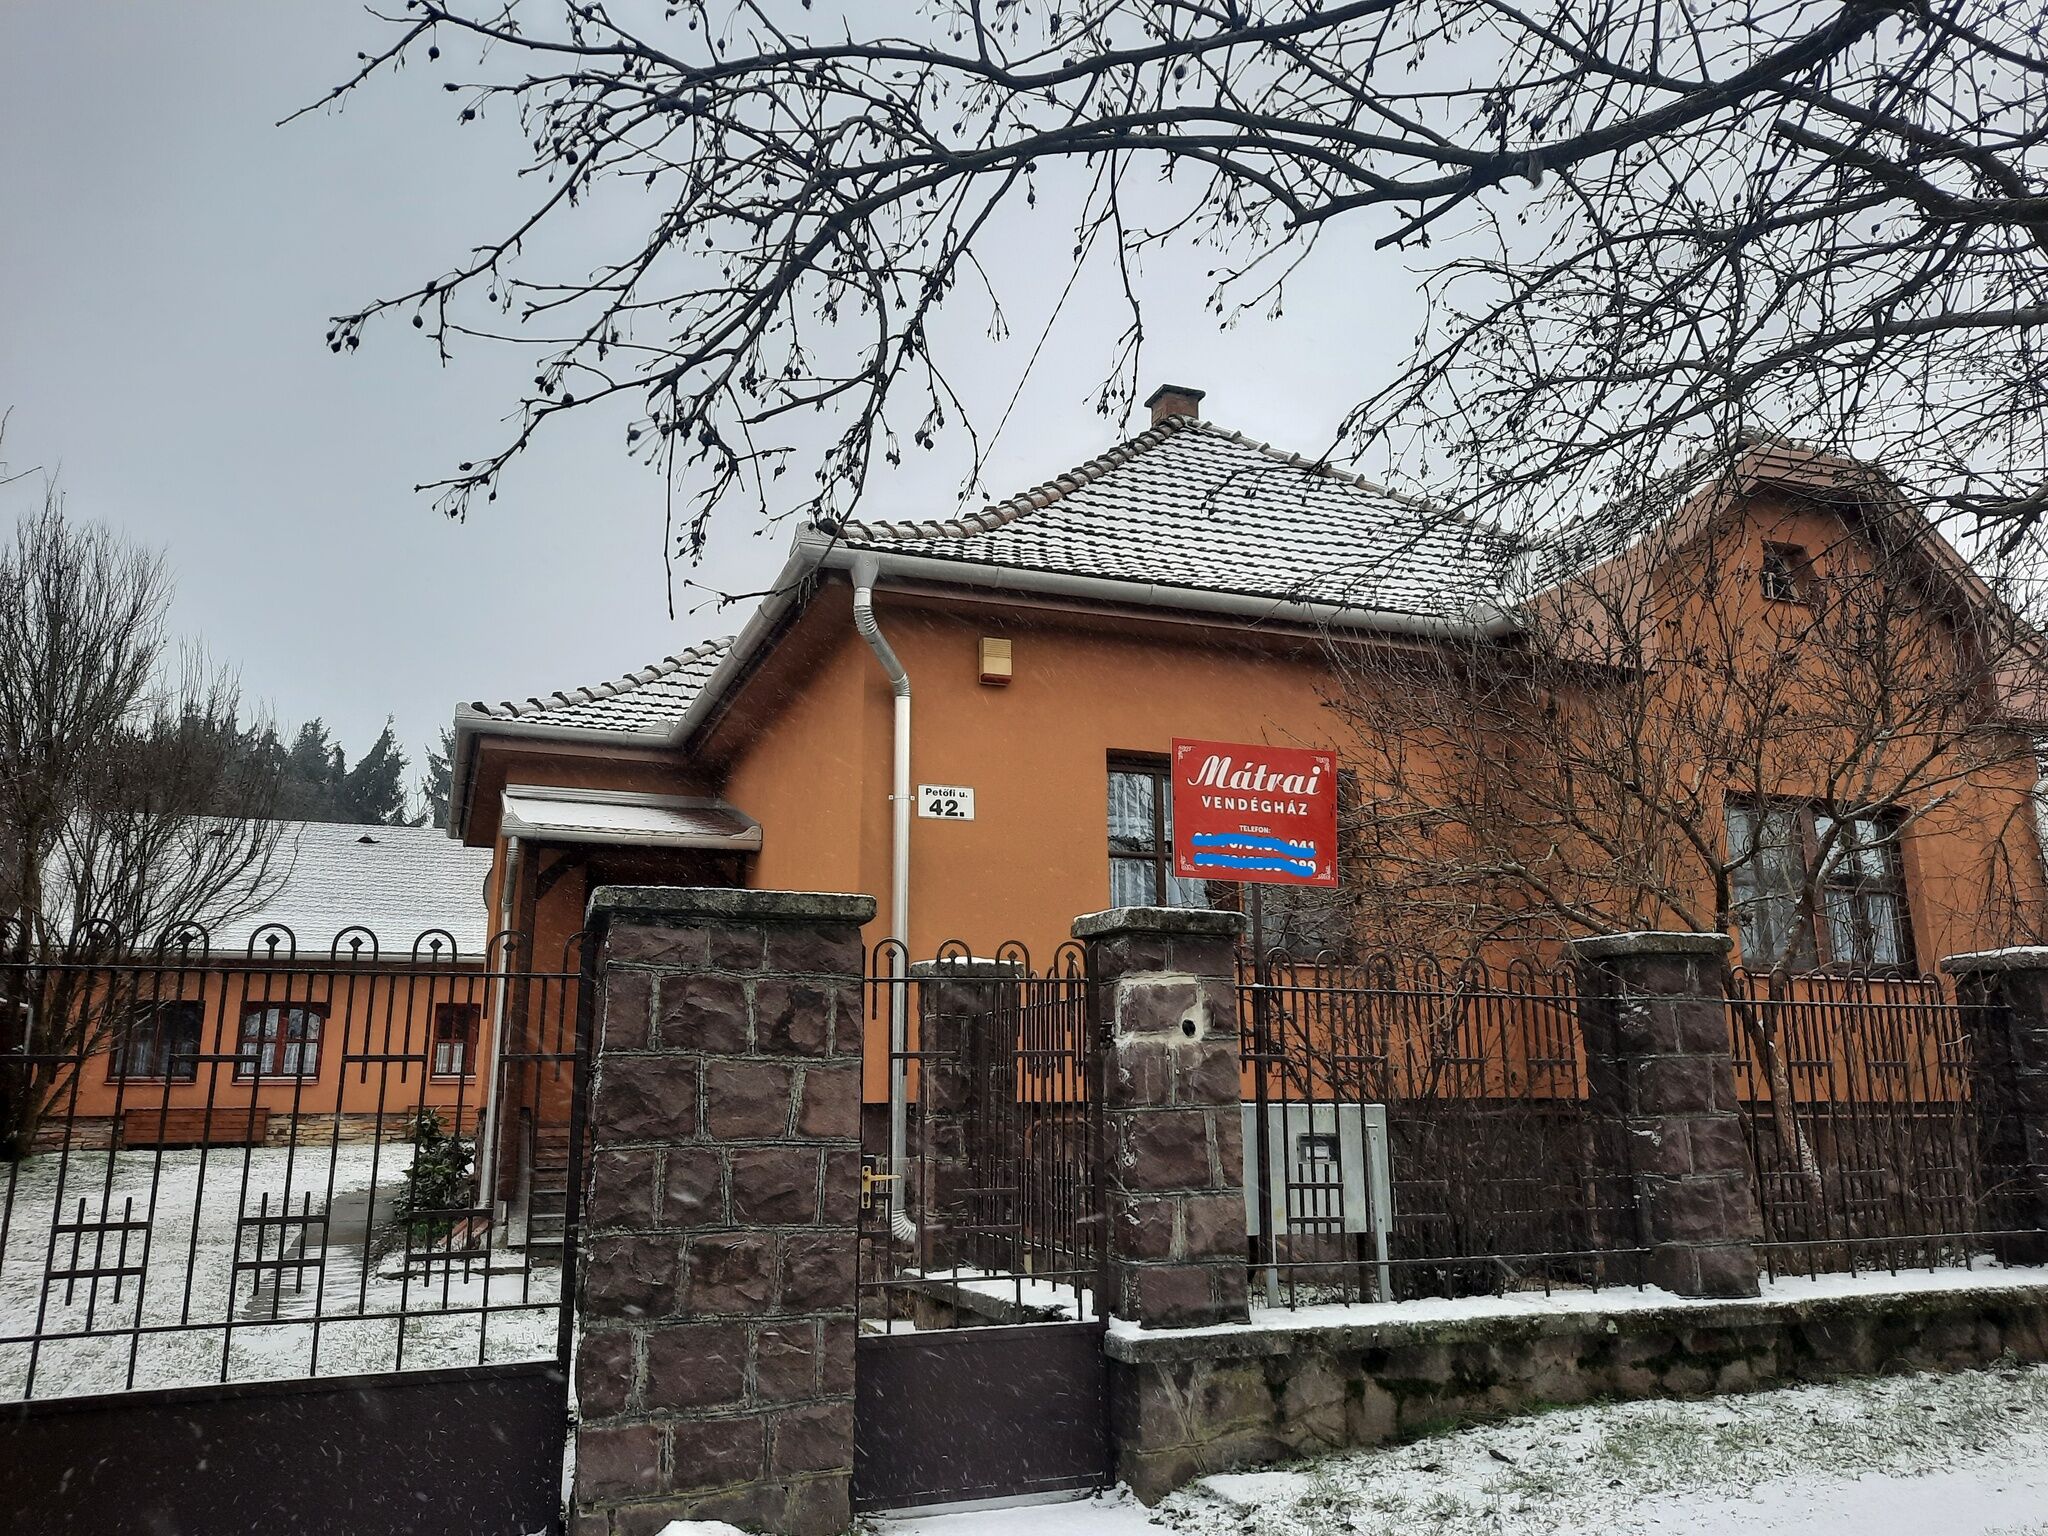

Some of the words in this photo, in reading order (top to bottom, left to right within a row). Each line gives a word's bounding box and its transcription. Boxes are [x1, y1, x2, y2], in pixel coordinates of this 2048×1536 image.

[1187, 754, 1322, 796] Mátrai
[925, 788, 956, 797] Petőfi
[929, 799, 965, 817] 42.
[1201, 795, 1309, 816] VENDÉGHÁZ
[1238, 824, 1272, 834] TELEFON:
